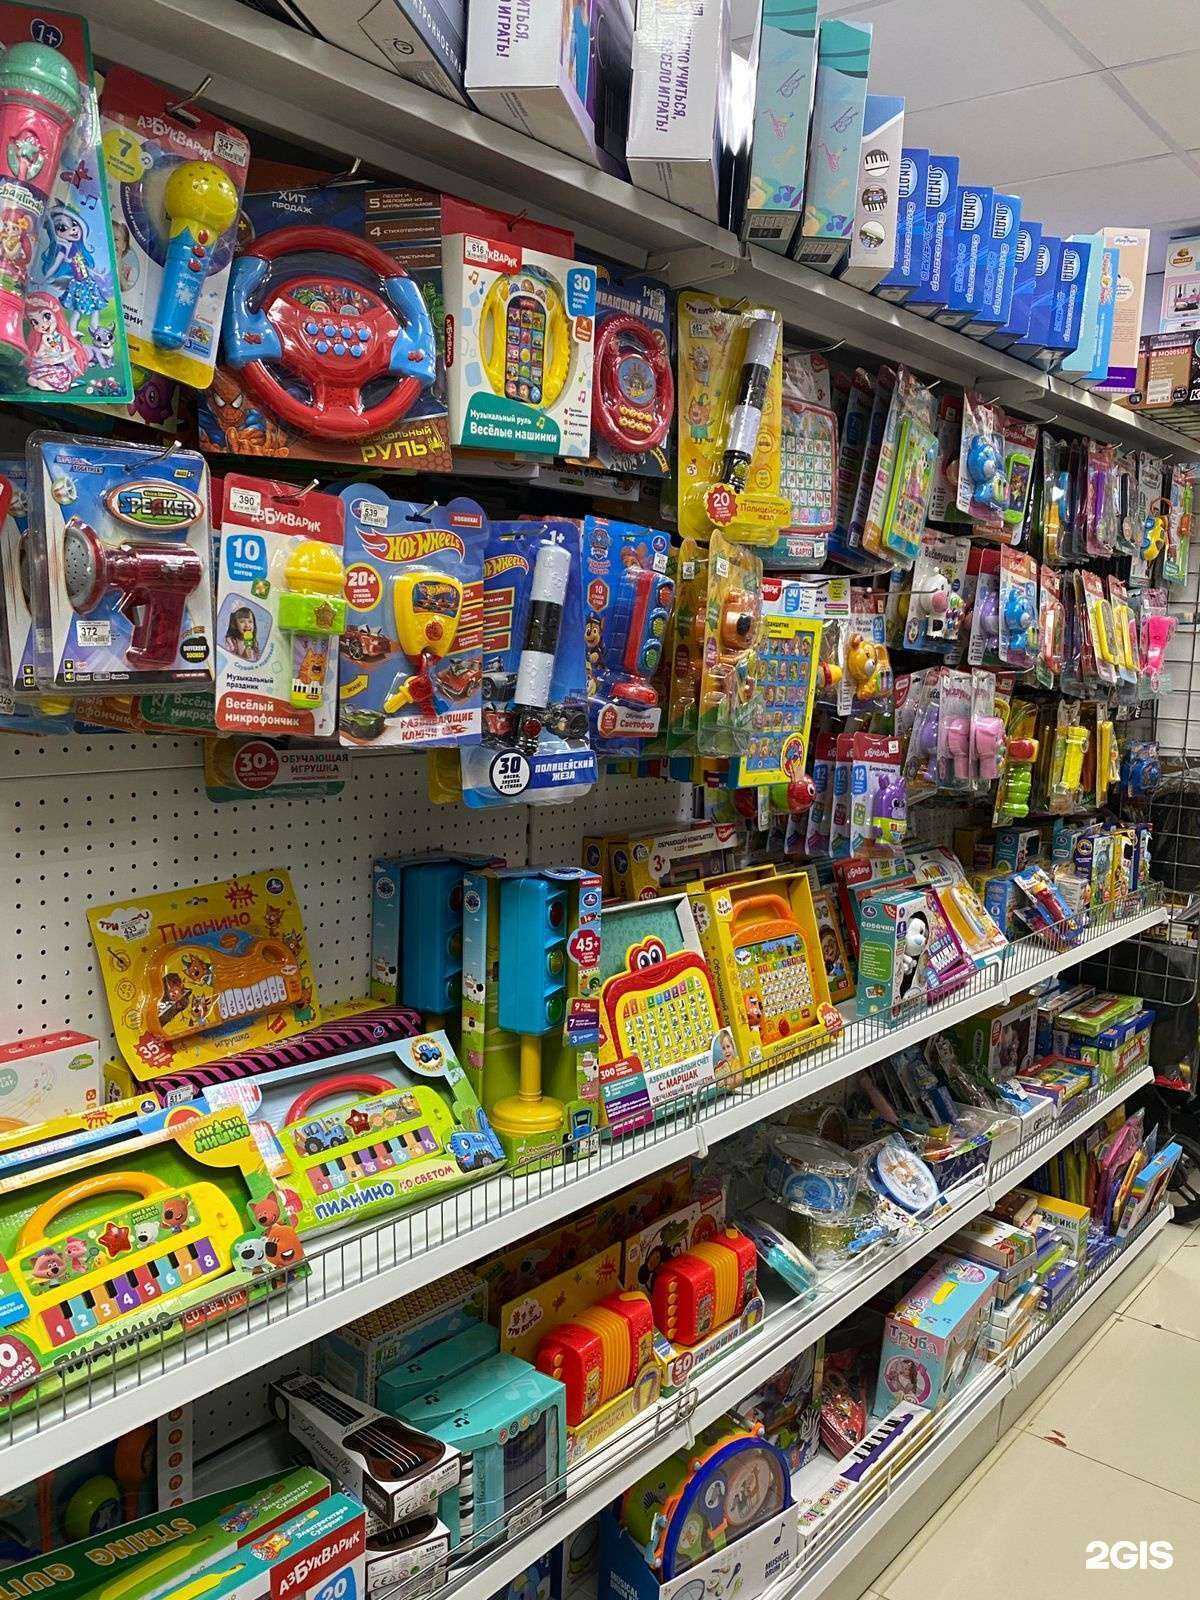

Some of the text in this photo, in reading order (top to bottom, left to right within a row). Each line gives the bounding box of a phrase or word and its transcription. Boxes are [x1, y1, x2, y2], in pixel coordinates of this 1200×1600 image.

[496, 6, 512, 58] ИГРАТЬ!
[672, 65, 690, 120] УЧИТЬСЯ,
[656, 86, 671, 133] ИГРАТЬ!
[278, 190, 308, 204] ХИТ
[369, 198, 381, 209] 5
[272, 201, 313, 215] ПРОДАЖ
[961, 191, 978, 232] SONATA
[370, 226, 382, 237] 4
[471, 243, 485, 254] 616
[573, 273, 591, 292] 30
[470, 408, 532, 427] Музыкальный руль
[470, 421, 557, 444] Весёлые машинки
[361, 440, 428, 464] РУЛЬ
[238, 496, 255, 507] 390
[712, 493, 730, 508] 20
[233, 537, 260, 562] 10
[347, 571, 377, 587] 20+
[81, 627, 98, 637] 372
[226, 673, 274, 685] Музыкальный
[226, 682, 260, 691] праздник
[225, 696, 274, 713] Весёлый
[225, 710, 300, 728] микрофончик
[281, 753, 349, 764] ОБУЧАЮЩАЯ
[499, 757, 521, 775] 30
[535, 757, 595, 773] ПОЛИЦЕЙСКИЙ
[290, 763, 340, 774] ИГРУШКА
[552, 770, 576, 782] ЖЕЗЛ
[158, 912, 251, 944] Пианино
[576, 936, 600, 952] 45+
[214, 1032, 251, 1049] игрушка
[139, 1041, 161, 1059] 35
[600, 1066, 615, 1080] 300
[667, 1069, 698, 1088] МАРШАК
[194, 1125, 250, 1153] МИШКИ
[315, 1165, 455, 1221] ПИАНИНО СО СВЕТОМ
[184, 1263, 194, 1276] 7
[203, 1255, 215, 1268] 8
[165, 1273, 176, 1286] 6
[143, 1282, 156, 1297] 5
[123, 1292, 134, 1305] 4
[100, 1303, 112, 1317] 3
[77, 1313, 89, 1328] 2
[56, 1325, 66, 1338] 1
[889, 1324, 937, 1354] Труба
[84, 1517, 197, 1566] STRING
[279, 1531, 360, 1596] АЗБУКВАРИК
[322, 1577, 348, 1600] 20
